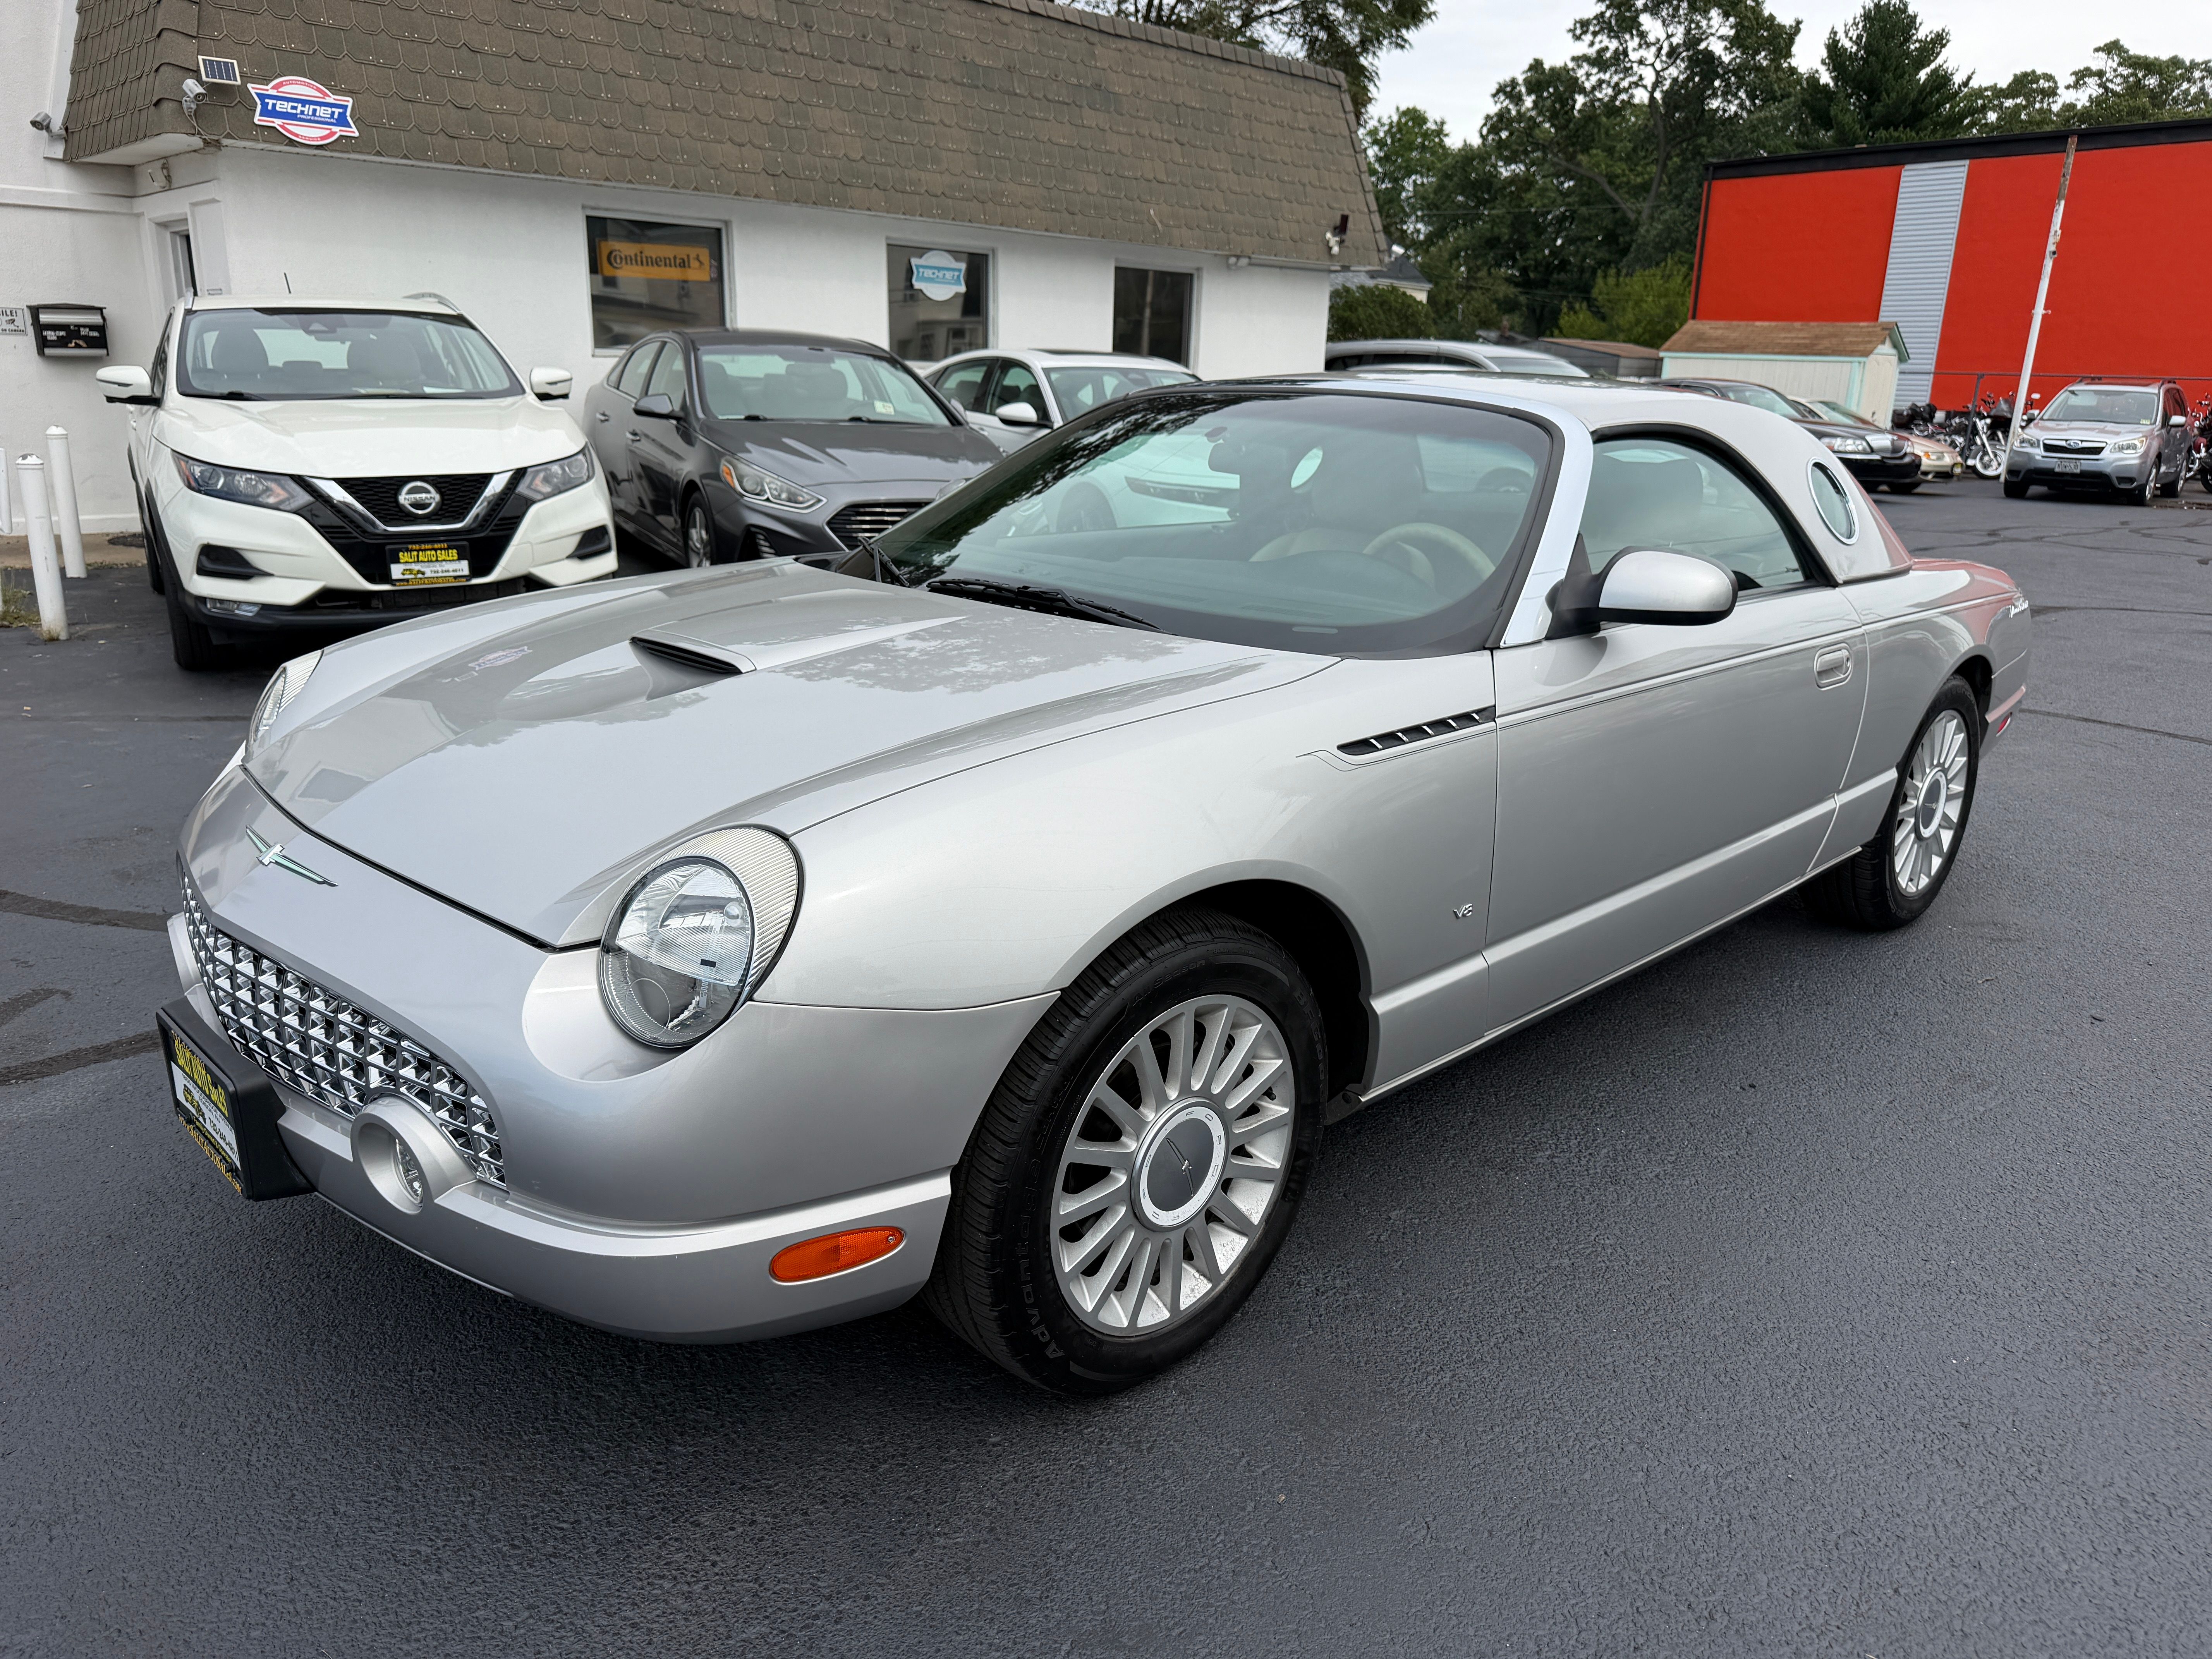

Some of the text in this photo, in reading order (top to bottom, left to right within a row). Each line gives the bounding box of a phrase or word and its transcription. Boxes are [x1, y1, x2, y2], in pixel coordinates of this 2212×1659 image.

[297, 114, 337, 123] PROFESSIONAL
[607, 249, 691, 269] Continental
[399, 549, 458, 562] SALIT AUTO SALES
[207, 1073, 228, 1118] SALES
